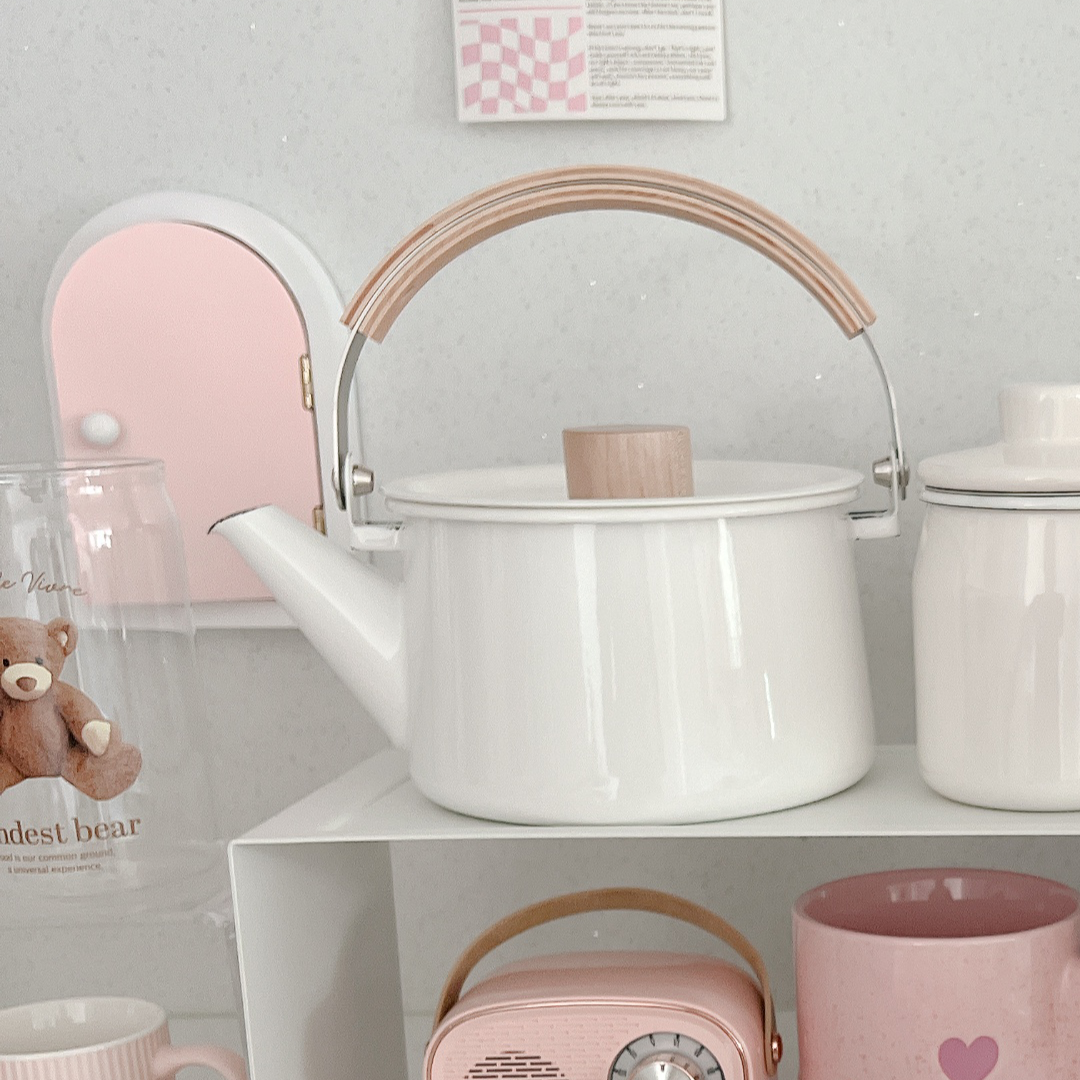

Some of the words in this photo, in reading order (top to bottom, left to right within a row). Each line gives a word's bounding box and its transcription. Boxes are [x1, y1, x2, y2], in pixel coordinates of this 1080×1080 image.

[72, 816, 141, 842] bear
[38, 852, 77, 862] common
[13, 864, 49, 874] universal
